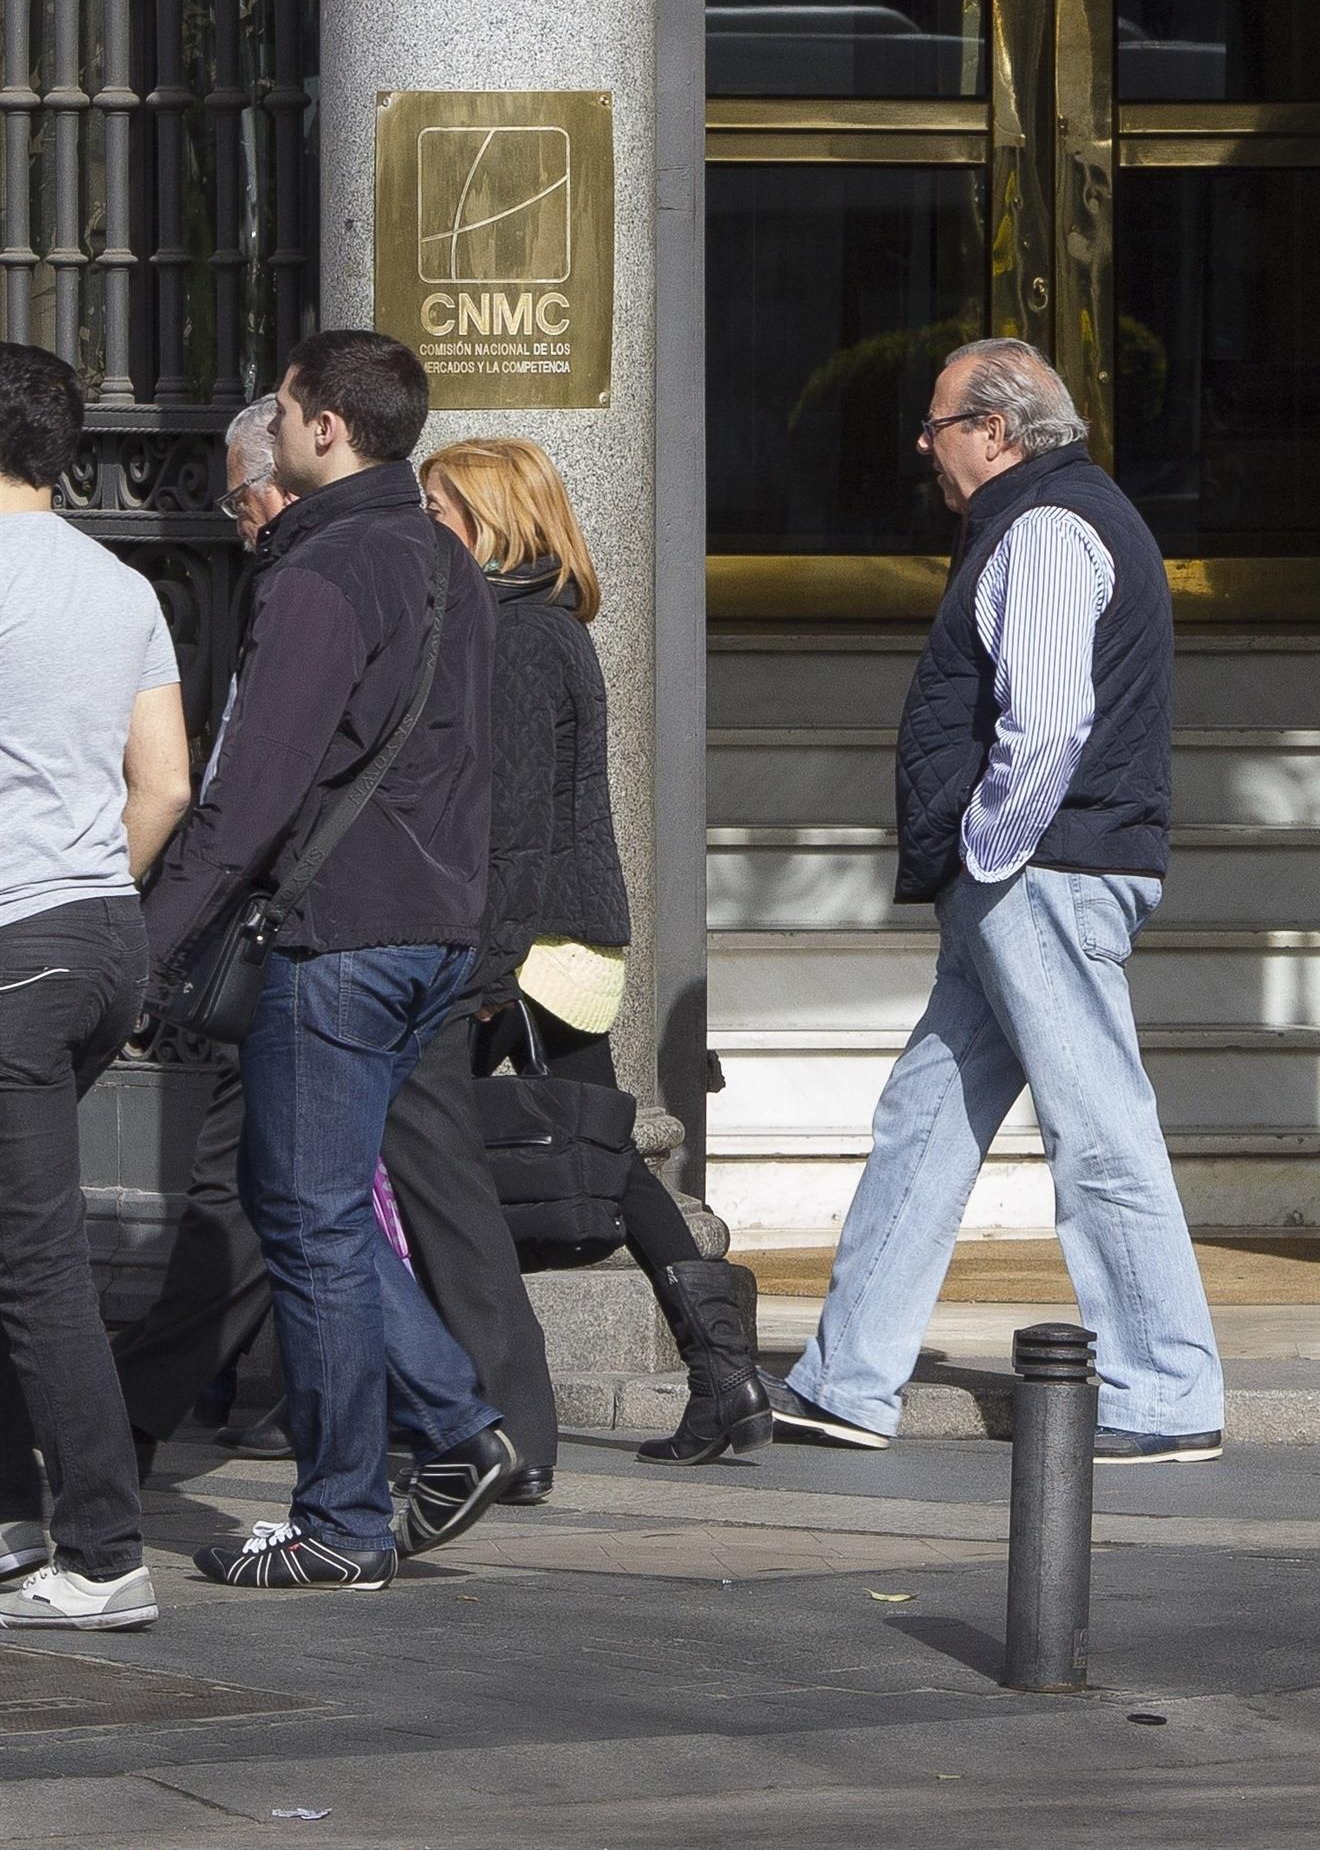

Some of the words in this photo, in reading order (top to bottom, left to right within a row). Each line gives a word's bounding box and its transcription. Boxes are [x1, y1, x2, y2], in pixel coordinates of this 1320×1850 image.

[420, 292, 570, 336] CNMC
[420, 341, 472, 356] COMISIÓN
[475, 343, 530, 356] NACIONAL
[533, 343, 548, 356] DE
[550, 343, 571, 356] LOS
[477, 361, 484, 373] Y
[486, 361, 500, 374] LA
[502, 361, 571, 373] COMPETENCIA
